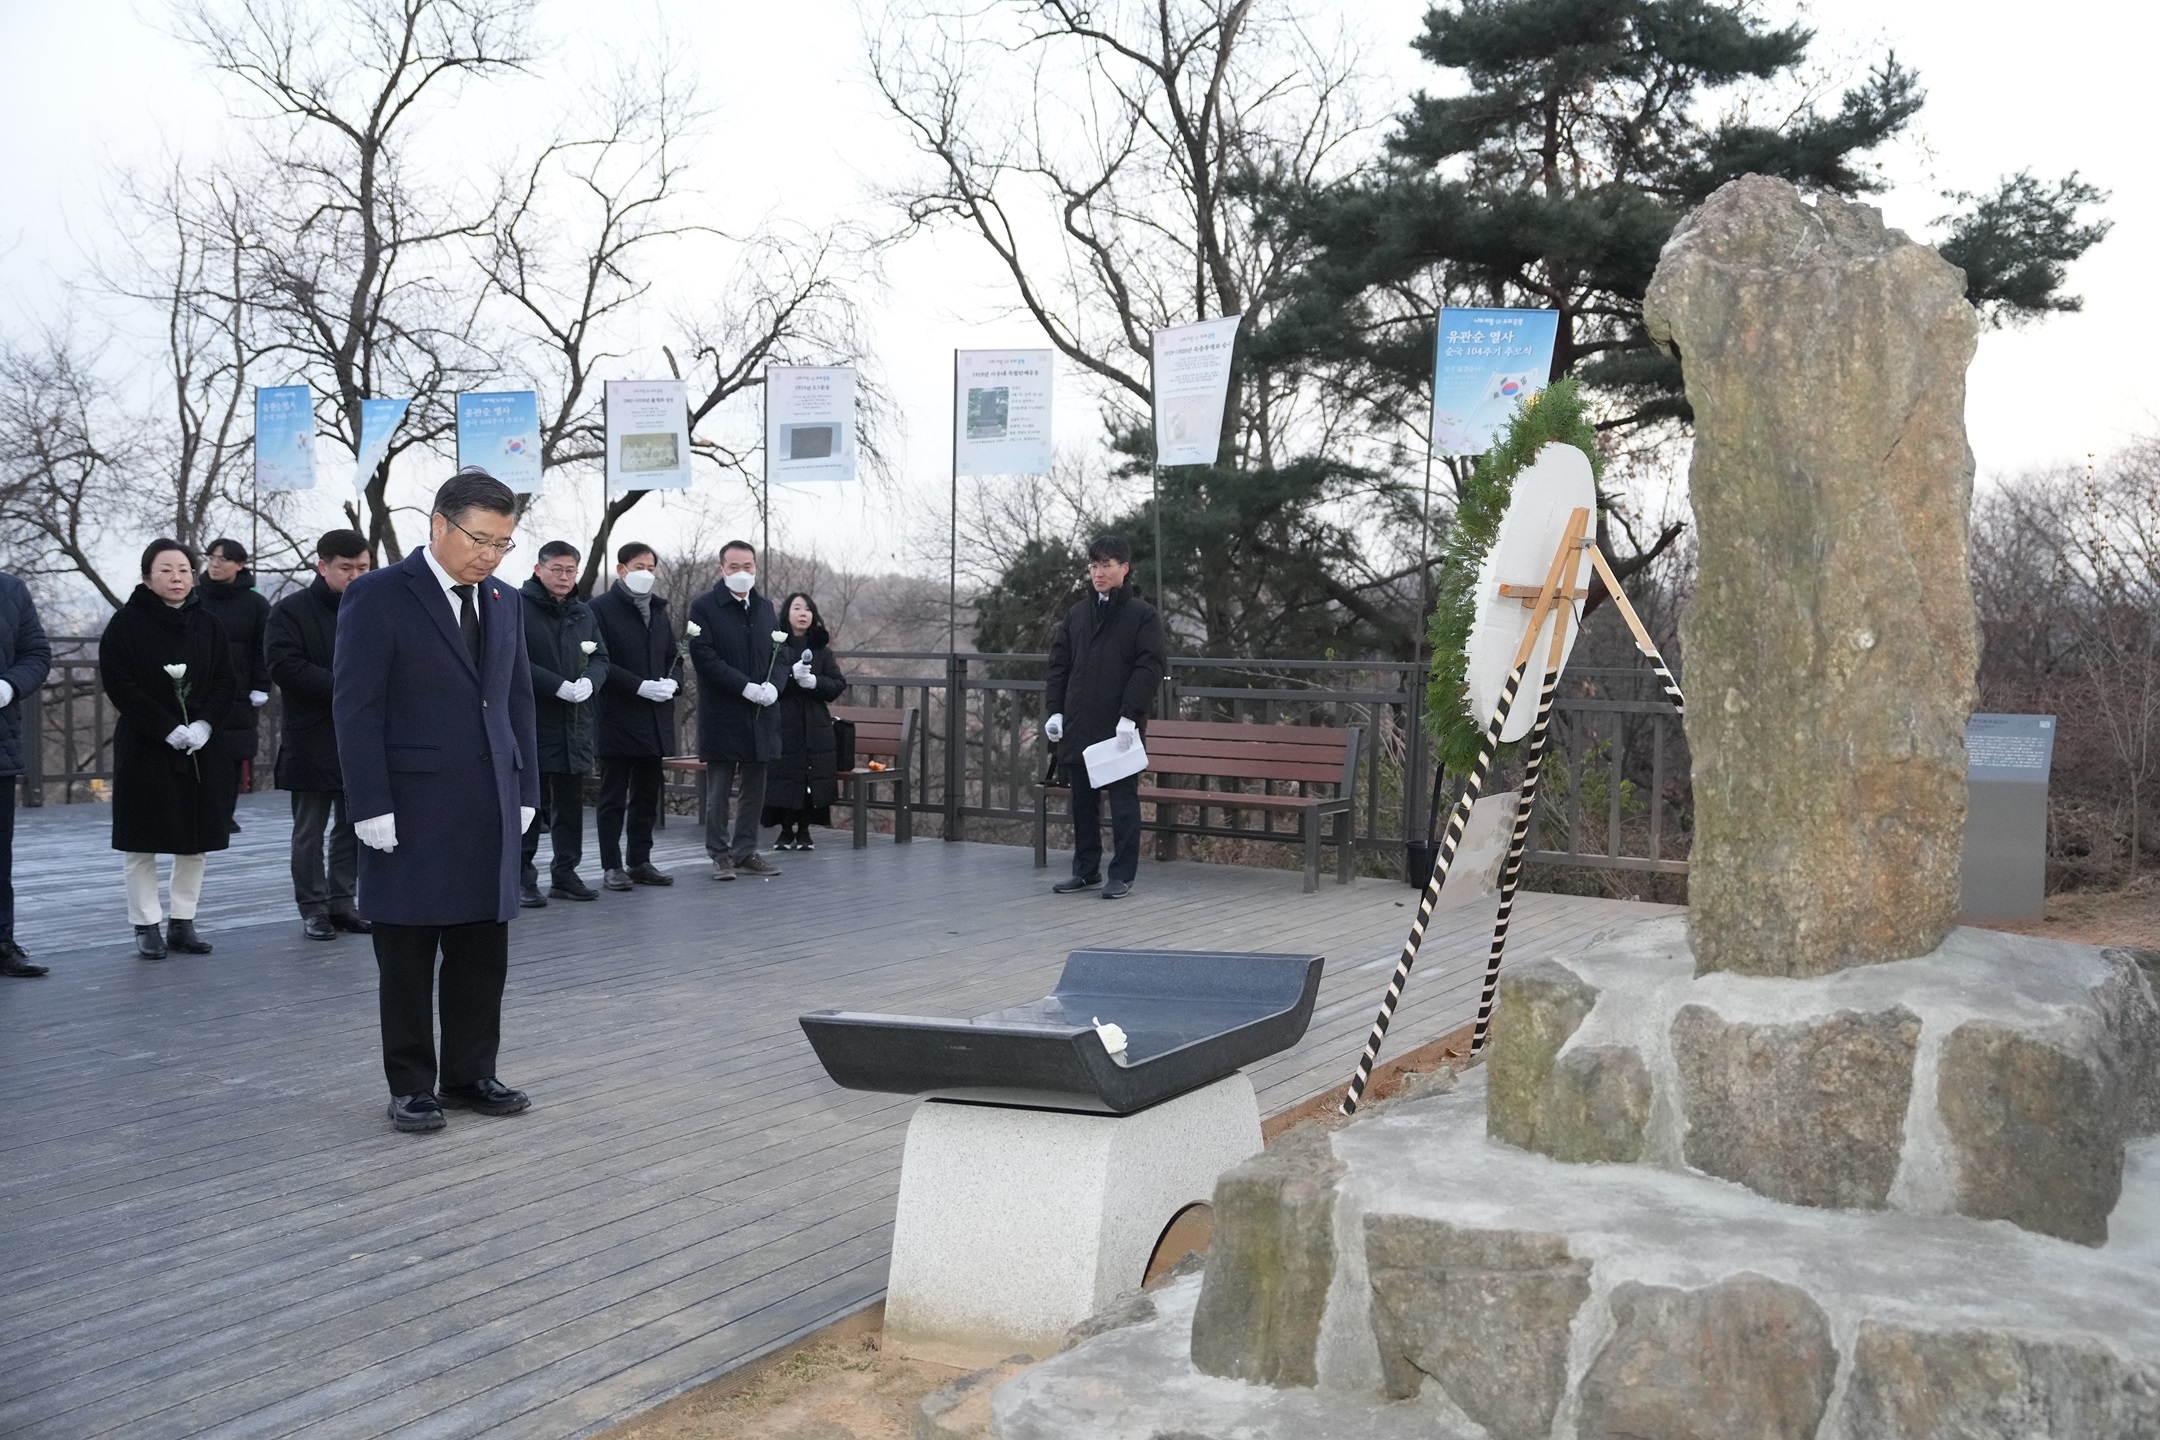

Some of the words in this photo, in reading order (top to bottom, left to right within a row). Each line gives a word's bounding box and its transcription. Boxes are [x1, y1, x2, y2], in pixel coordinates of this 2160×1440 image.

[1446, 330, 1485, 344] 유관순
[1490, 330, 1514, 344] 열사
[1445, 347, 1464, 357] 순국
[1466, 347, 1501, 357] 104주기
[1503, 346, 1533, 357] 추모식
[1008, 369, 1039, 377] 독립만세운동
